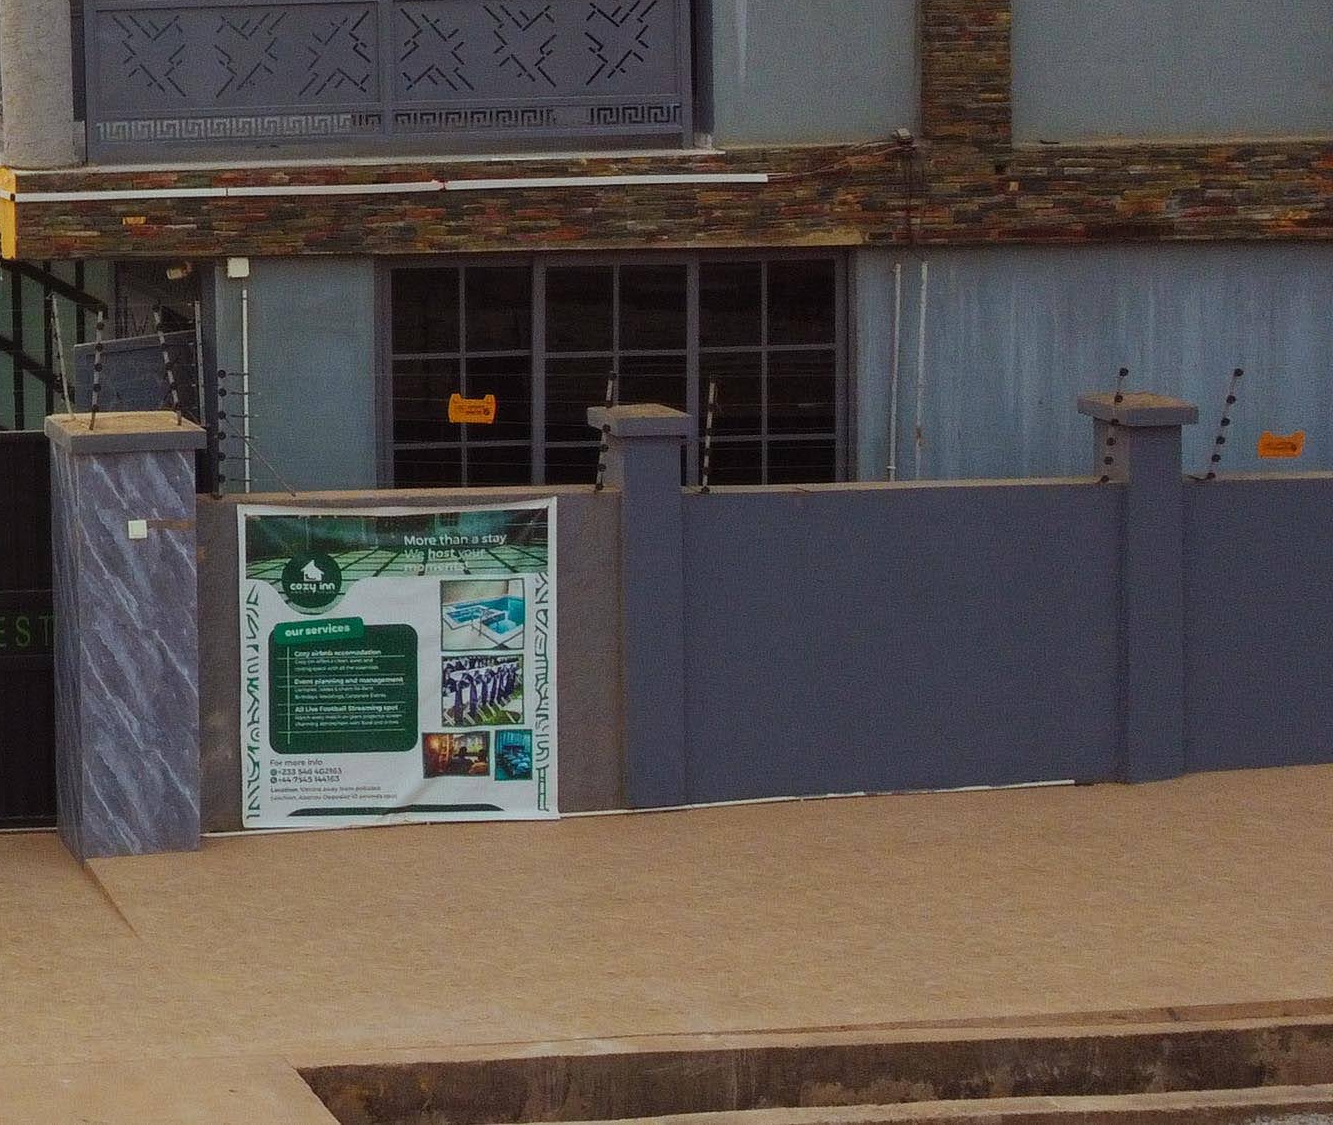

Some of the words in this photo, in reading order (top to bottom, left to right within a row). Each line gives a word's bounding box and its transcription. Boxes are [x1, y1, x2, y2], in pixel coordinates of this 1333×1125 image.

[403, 535, 438, 546] More
[439, 534, 469, 546] than
[471, 536, 479, 545] a
[481, 534, 507, 545] stay
[404, 549, 425, 559] We
[428, 548, 455, 559] host
[457, 549, 486, 560] your
[289, 583, 317, 593] cozy
[319, 582, 336, 590] inn
[285, 629, 304, 637] our
[305, 623, 351, 635] services
[359, 676, 404, 684] management
[348, 704, 382, 713] Streaming
